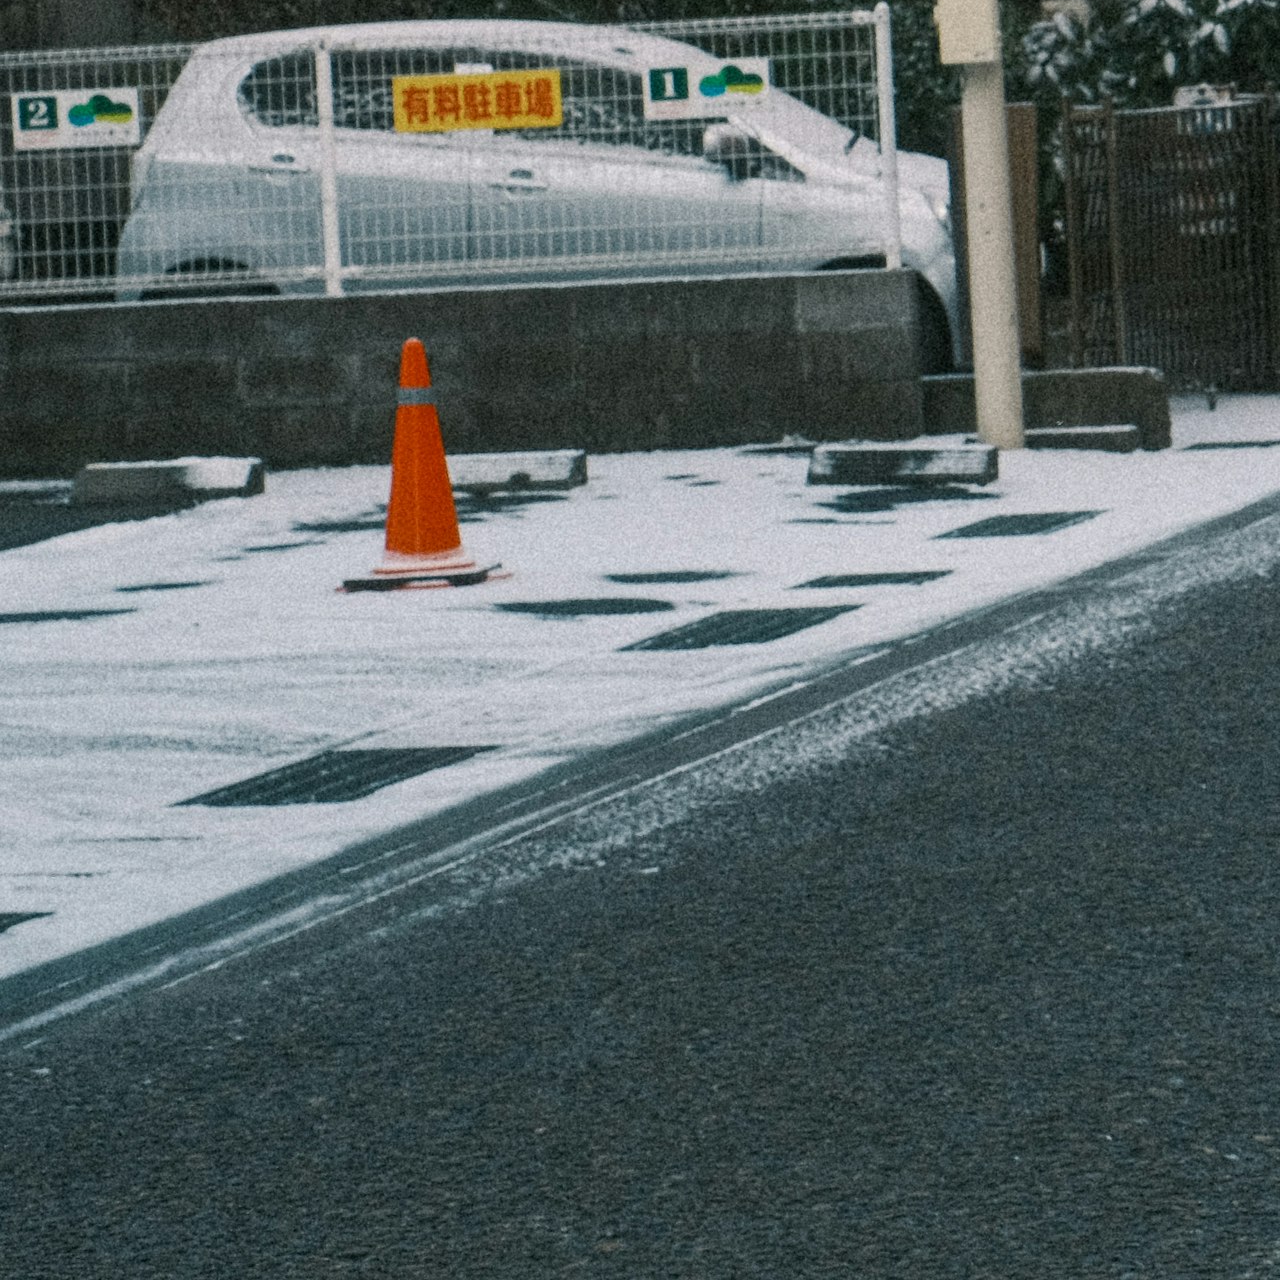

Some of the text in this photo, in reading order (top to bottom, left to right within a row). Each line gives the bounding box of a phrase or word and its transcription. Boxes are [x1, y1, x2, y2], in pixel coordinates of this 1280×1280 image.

[28, 99, 49, 127] 2
[402, 77, 555, 124] 有料駐車場
